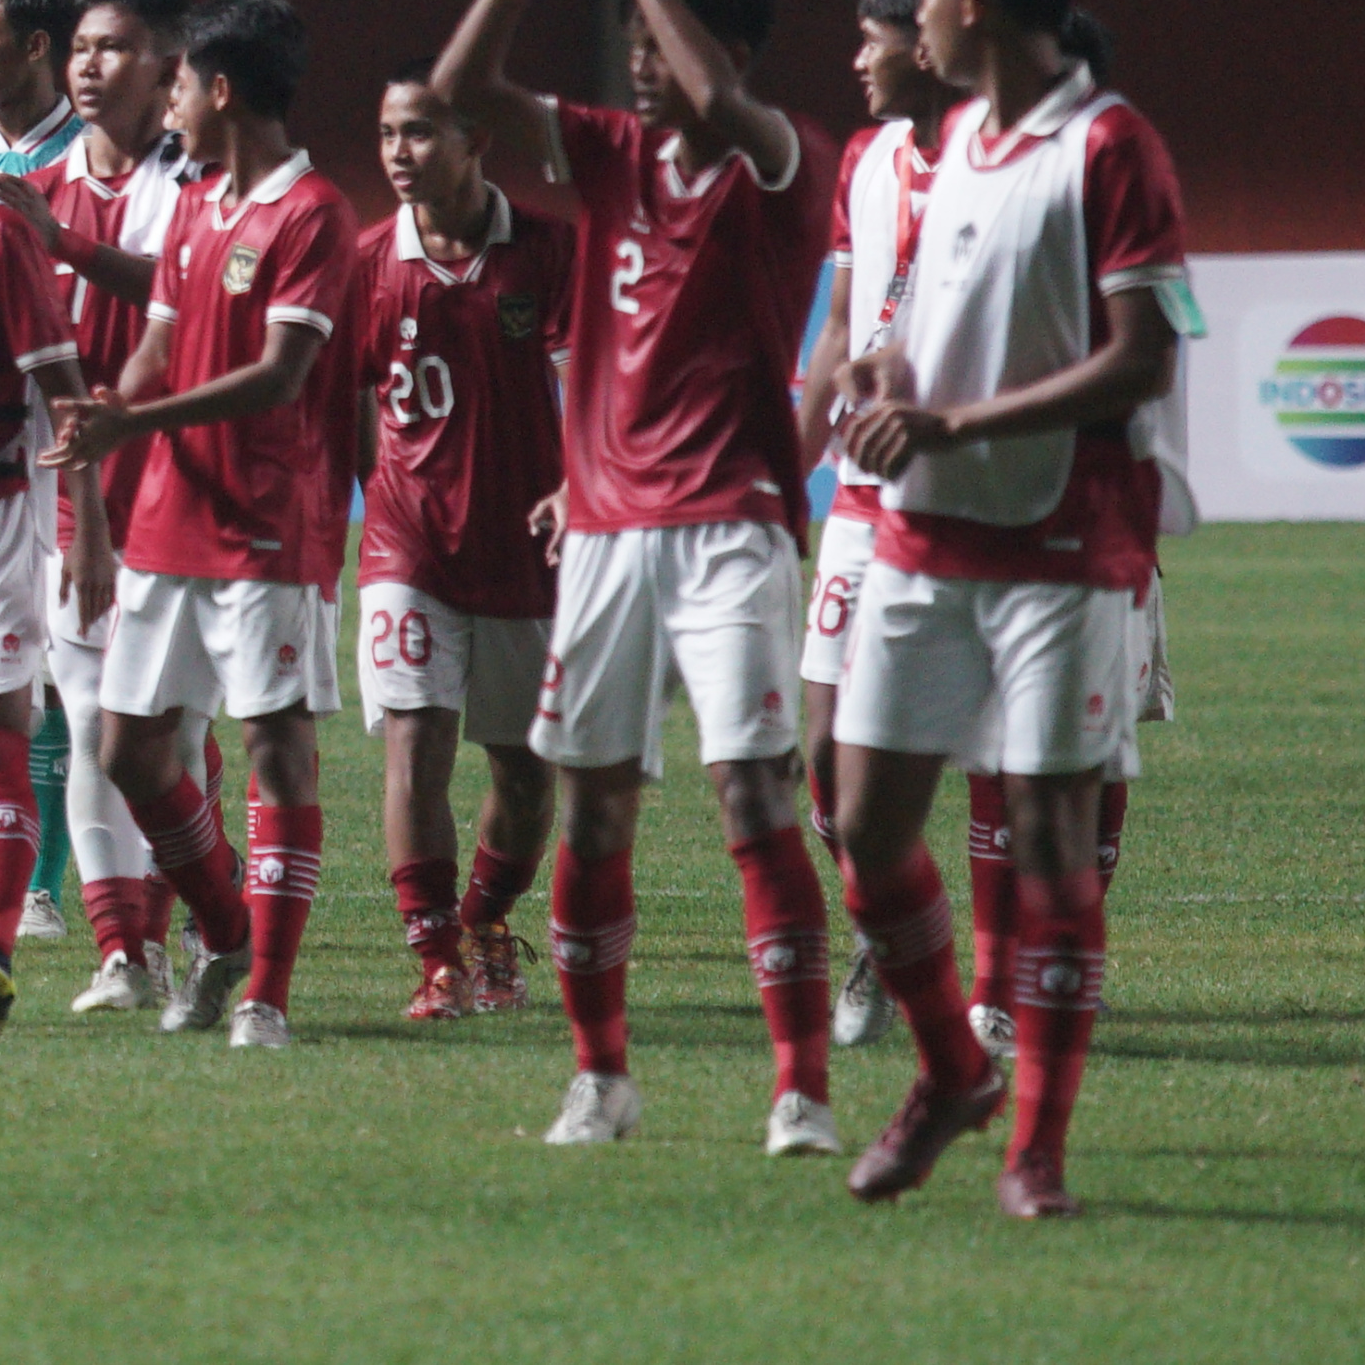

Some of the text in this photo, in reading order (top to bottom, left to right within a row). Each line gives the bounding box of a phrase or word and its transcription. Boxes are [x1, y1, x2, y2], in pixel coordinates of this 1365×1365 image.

[609, 240, 644, 315] 2
[389, 355, 454, 424] 20
[370, 609, 432, 671] 20
